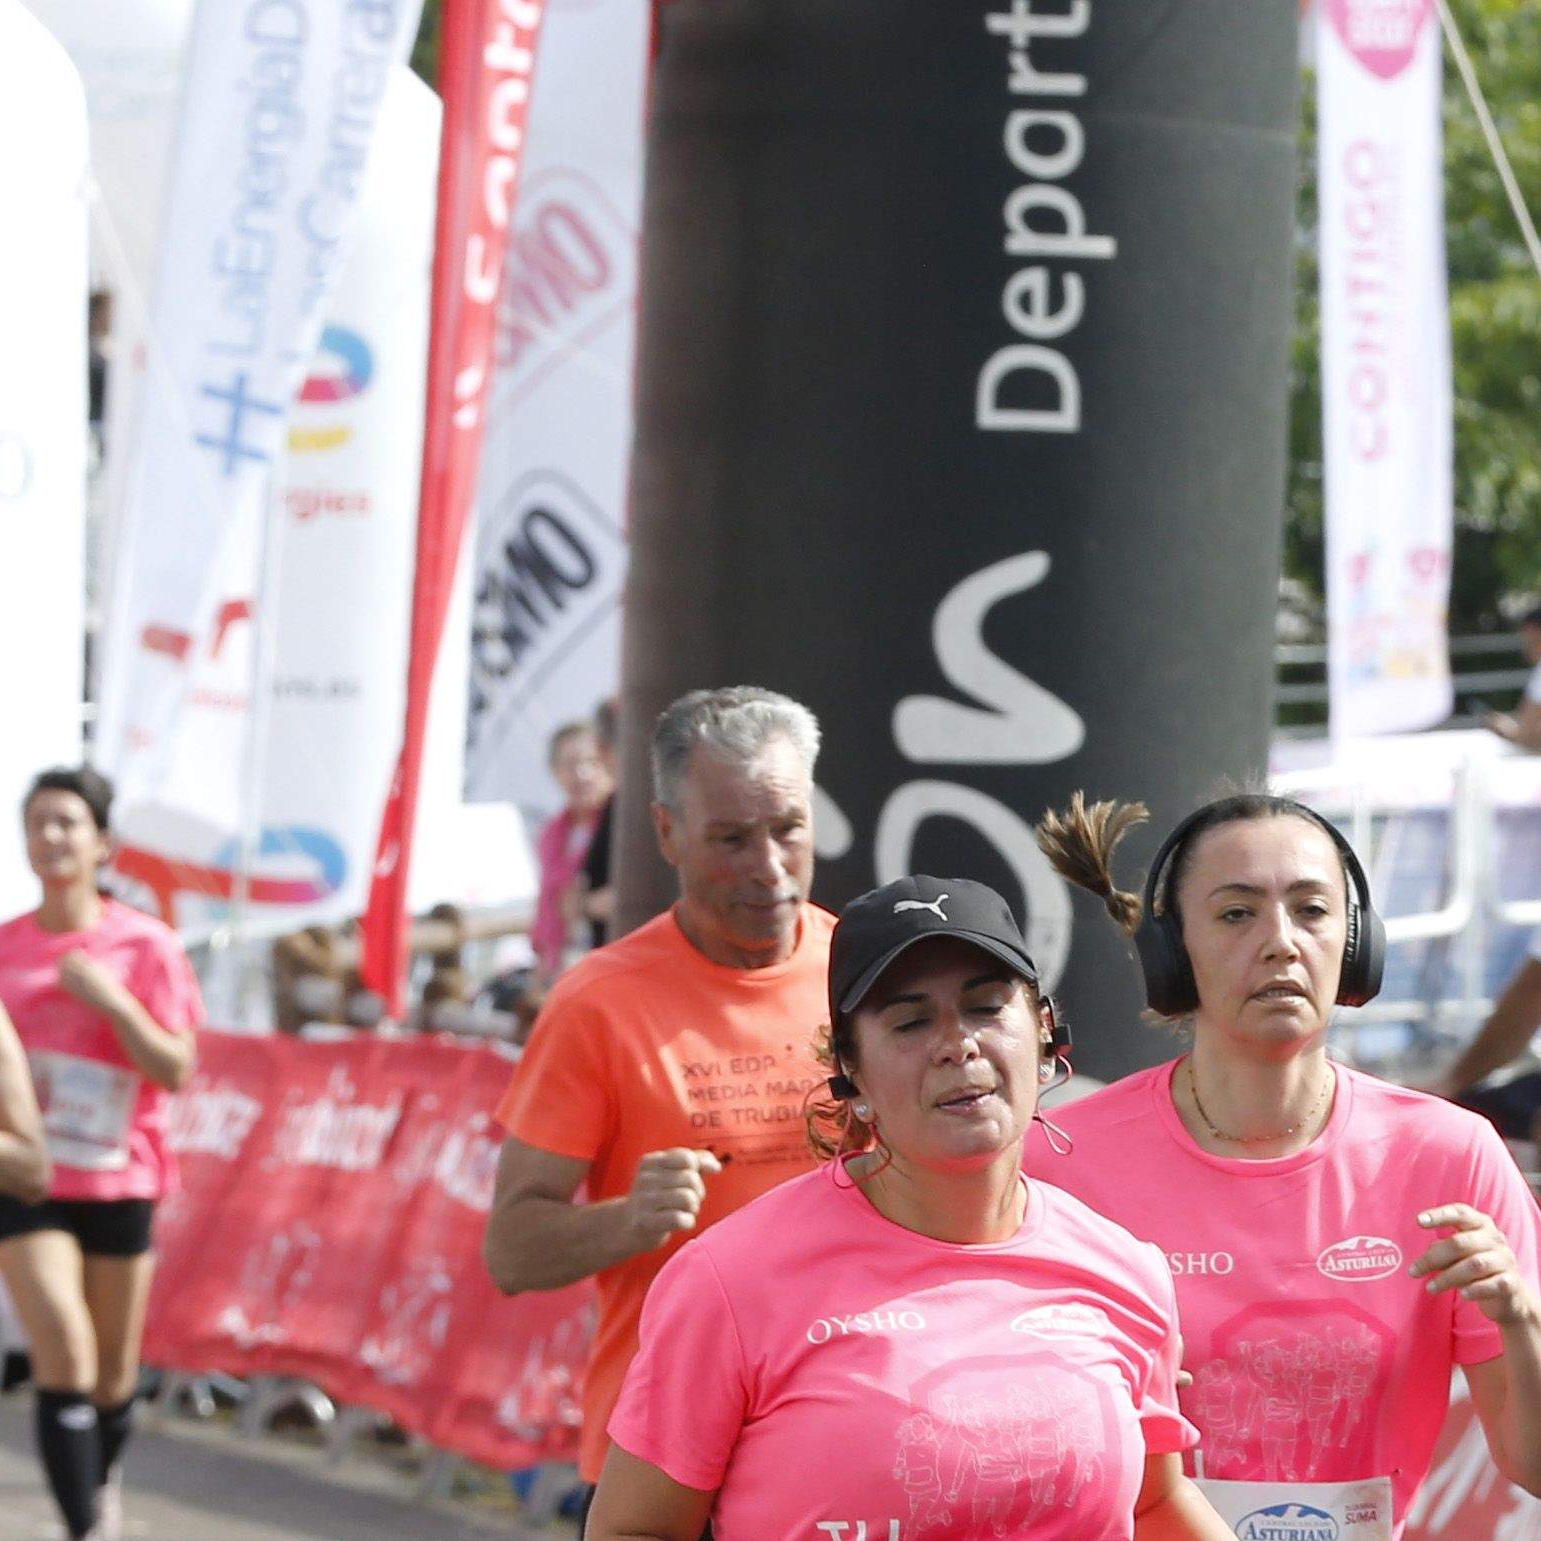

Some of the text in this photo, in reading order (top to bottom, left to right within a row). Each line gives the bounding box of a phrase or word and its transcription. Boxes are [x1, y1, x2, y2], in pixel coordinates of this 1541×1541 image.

[690, 1084, 758, 1101] MEDIA
[691, 1110, 722, 1129] DE
[807, 1311, 927, 1344] OYSHO
[1345, 1510, 1377, 1525] SUMA
[1243, 1522, 1333, 1541] ASTURIANA
